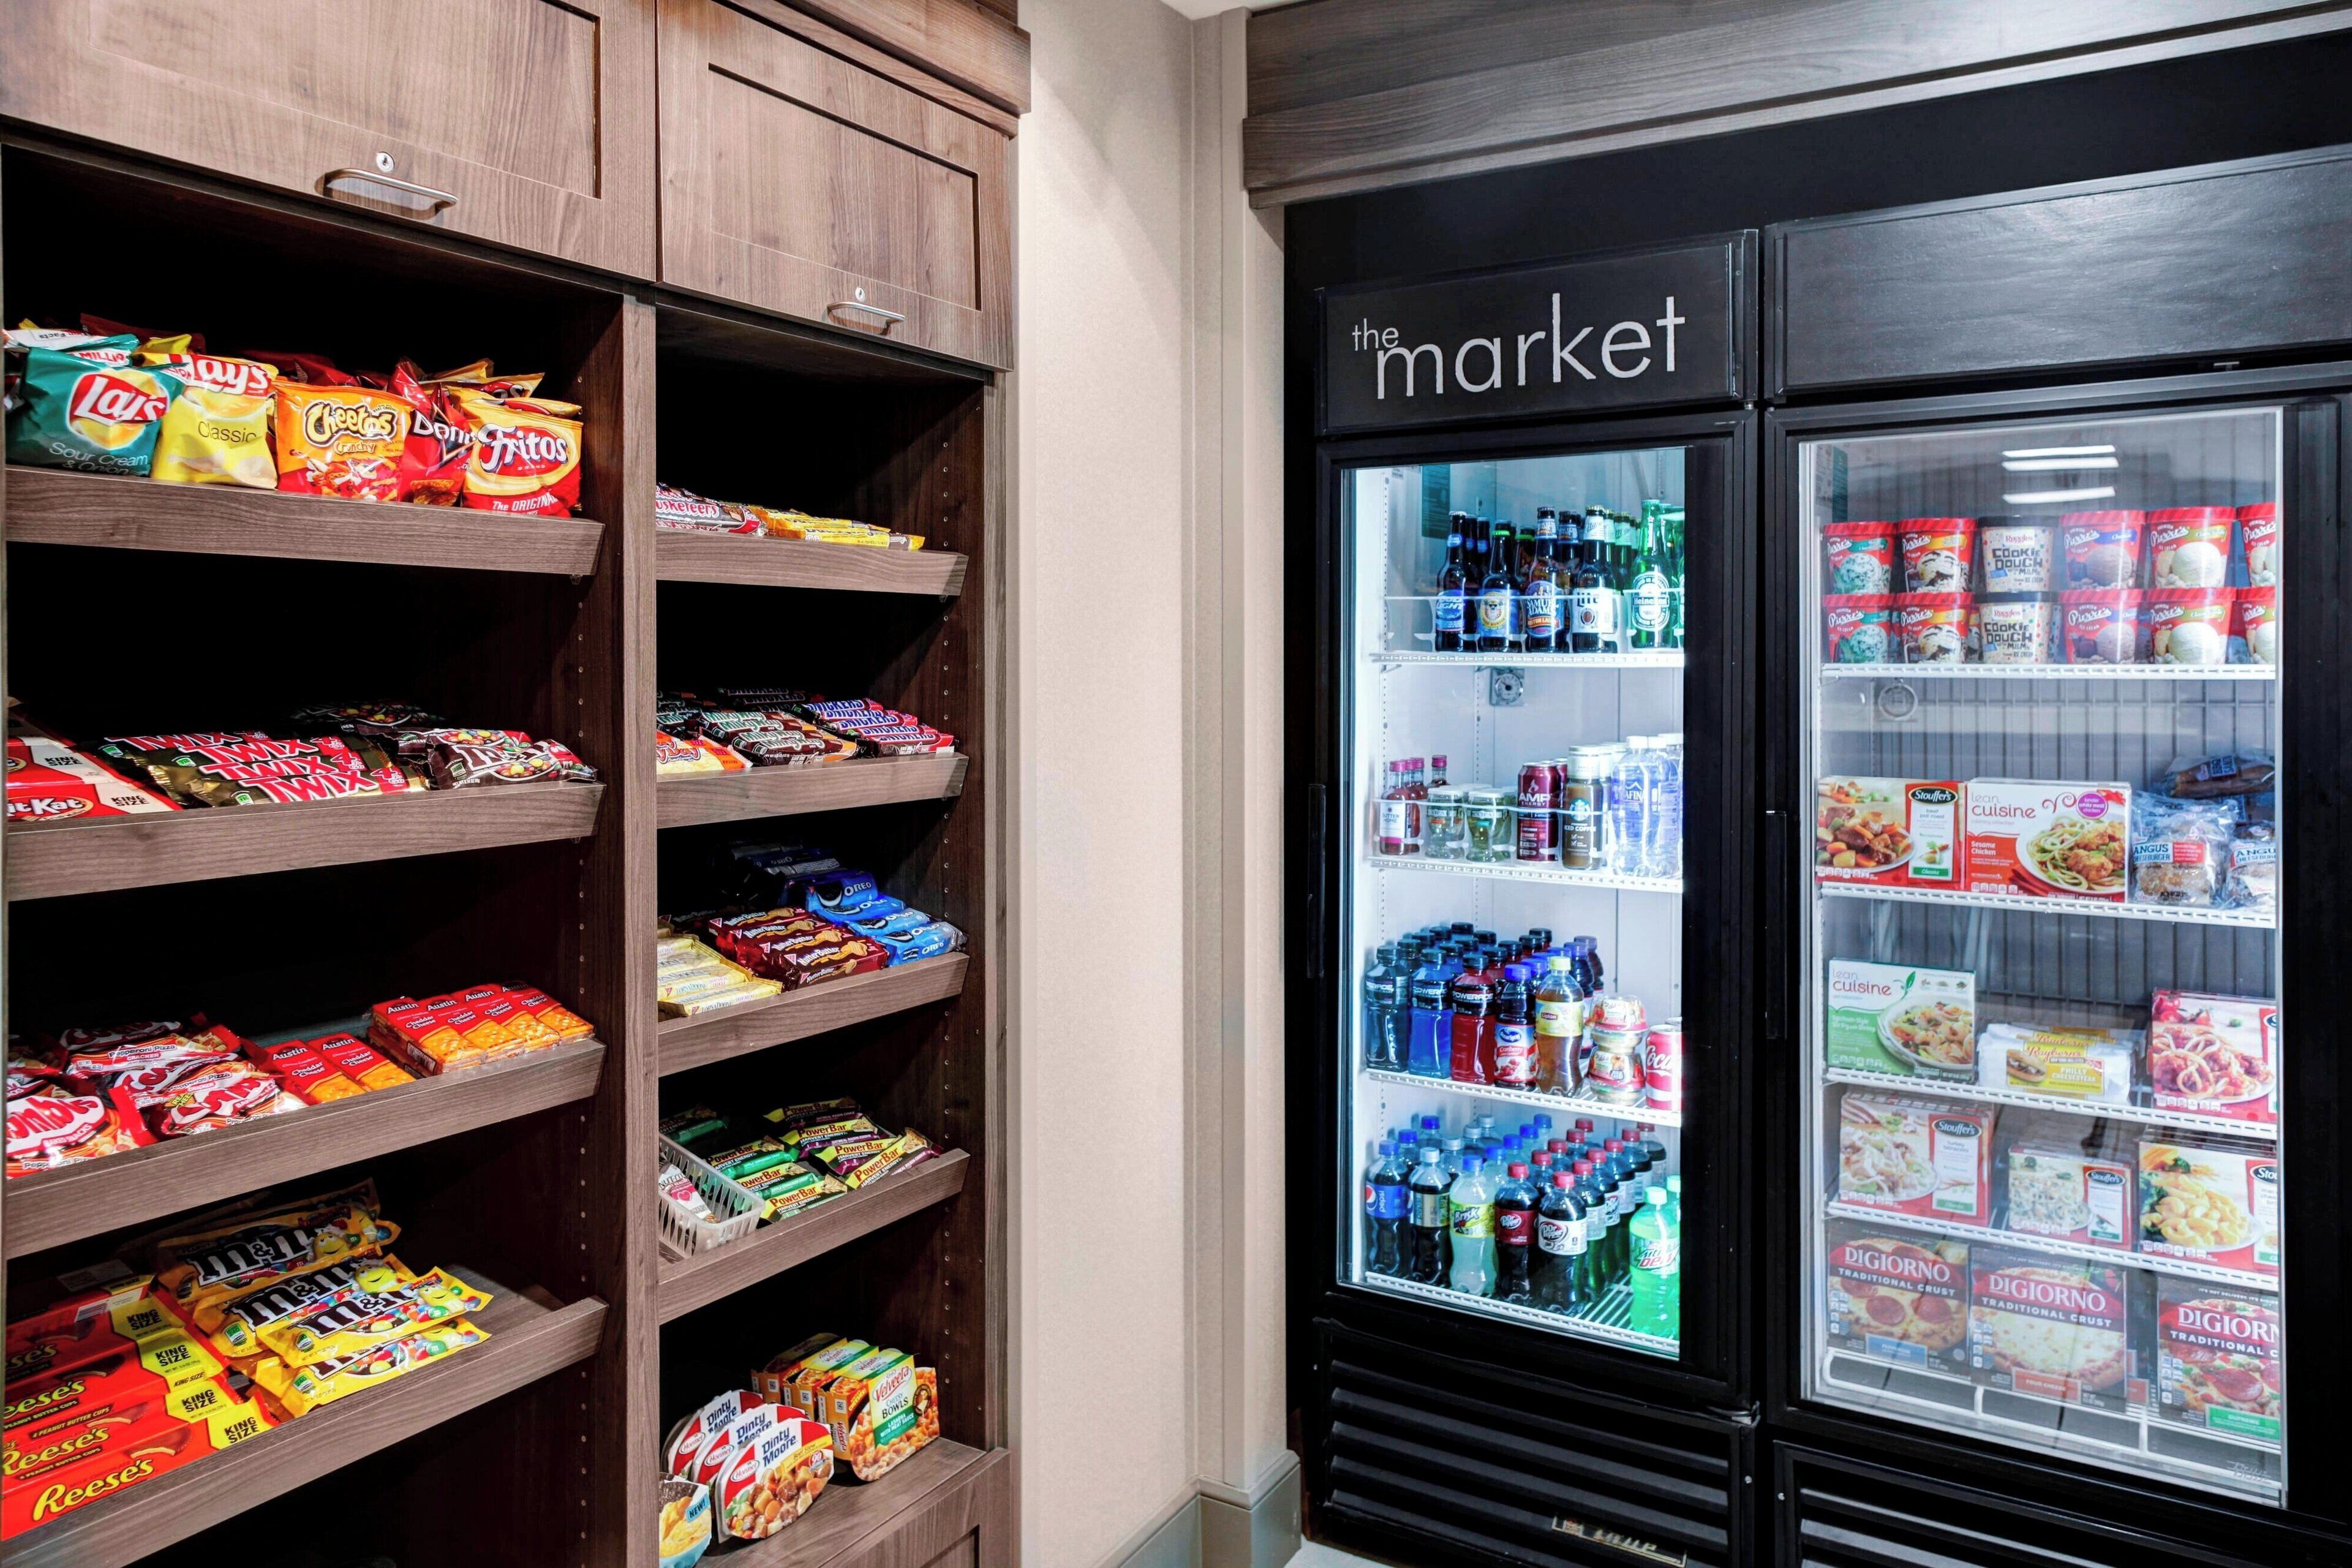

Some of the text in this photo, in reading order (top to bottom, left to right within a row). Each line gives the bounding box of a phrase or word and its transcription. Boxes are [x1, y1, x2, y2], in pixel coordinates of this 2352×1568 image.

[1352, 318, 1399, 351] the
[1377, 293, 1686, 400] market
[74, 376, 167, 426] Lay's
[198, 420, 257, 444] Classic
[305, 402, 397, 447] Cheetos
[49, 442, 148, 466] Sour Cream
[477, 423, 569, 472] Fritos
[492, 492, 558, 511] The ORIGINA
[655, 500, 720, 518] usketeers
[2243, 522, 2276, 543] Pierre
[1994, 558, 2043, 568] DOUGH
[1986, 632, 2033, 644] DOUGH
[104, 731, 243, 752] TWIX
[178, 739, 319, 765] TWIX
[198, 755, 341, 781] TWIX
[238, 770, 379, 804] TWIX
[1519, 791, 1551, 802] AMP
[1915, 789, 1953, 803] Stouffer's
[1971, 792, 2000, 804] lean
[1971, 804, 2037, 819] cuisine
[1971, 840, 1996, 849] Sesame
[1971, 848, 1997, 856] Chicken
[2134, 843, 2169, 854] ANGUS
[2236, 848, 2276, 856] ANGU
[844, 881, 872, 897] OREO
[921, 942, 944, 956] OREO
[1833, 968, 1858, 980] lean
[466, 989, 495, 1001] Austin
[1452, 990, 1494, 1001] POWERADE
[1833, 980, 1892, 997] cuisine
[387, 1003, 420, 1014] Austin
[427, 999, 458, 1011] Austin
[484, 1001, 510, 1015] Cheddar
[405, 1015, 434, 1028] Cheddar
[447, 1011, 474, 1023] Cheddar
[109, 1046, 152, 1058] Pepperoni
[322, 1038, 356, 1050] Austin
[273, 1046, 309, 1061] Austin
[341, 1050, 372, 1065] Cheddar
[291, 1061, 324, 1076] Cheddar
[797, 1123, 847, 1138] PowerBar
[1938, 1121, 1976, 1136] Stouffer's
[834, 1141, 884, 1155] PowerBar
[854, 1146, 899, 1182] PowerBar
[2090, 1171, 2124, 1185] Stouffer's
[769, 1186, 817, 1207] PowerBar
[1845, 1246, 1951, 1283] DIGIORNO
[1838, 1267, 1956, 1297] TRADITIONAL CRUST
[1989, 1274, 2107, 1312] DIGIORNO
[126, 1309, 159, 1324] KING
[1982, 1296, 2113, 1328] TRADITIONAL CRUST
[130, 1316, 162, 1331] SIZE
[2178, 1306, 2279, 1343] DIGIORN
[2170, 1330, 2265, 1355] TRADITIONAL
[155, 1344, 187, 1361] KING
[159, 1352, 191, 1367] SIZE
[173, 1371, 205, 1387] KING SIZE
[875, 1365, 910, 1402] Velveeta
[5, 1380, 86, 1420] eese's
[181, 1389, 214, 1406] KING
[186, 1396, 218, 1413] SIZE
[33, 1406, 59, 1420] BUTTER
[60, 1400, 78, 1409] CUPS
[706, 1399, 732, 1427] Dinty
[882, 1396, 909, 1419] BOWLS
[39, 1406, 110, 1436] PEANUT BUTTER CUPS
[224, 1416, 257, 1436] KING
[736, 1412, 766, 1439] Dinty
[228, 1425, 259, 1444] SIZE
[762, 1428, 790, 1454] Dinty
[763, 1434, 797, 1468] Moore
[26, 1447, 102, 1479] PEANUT BUTTER CUPS
[33, 1460, 154, 1522] Reese's
[689, 1499, 706, 1519] NEW!
